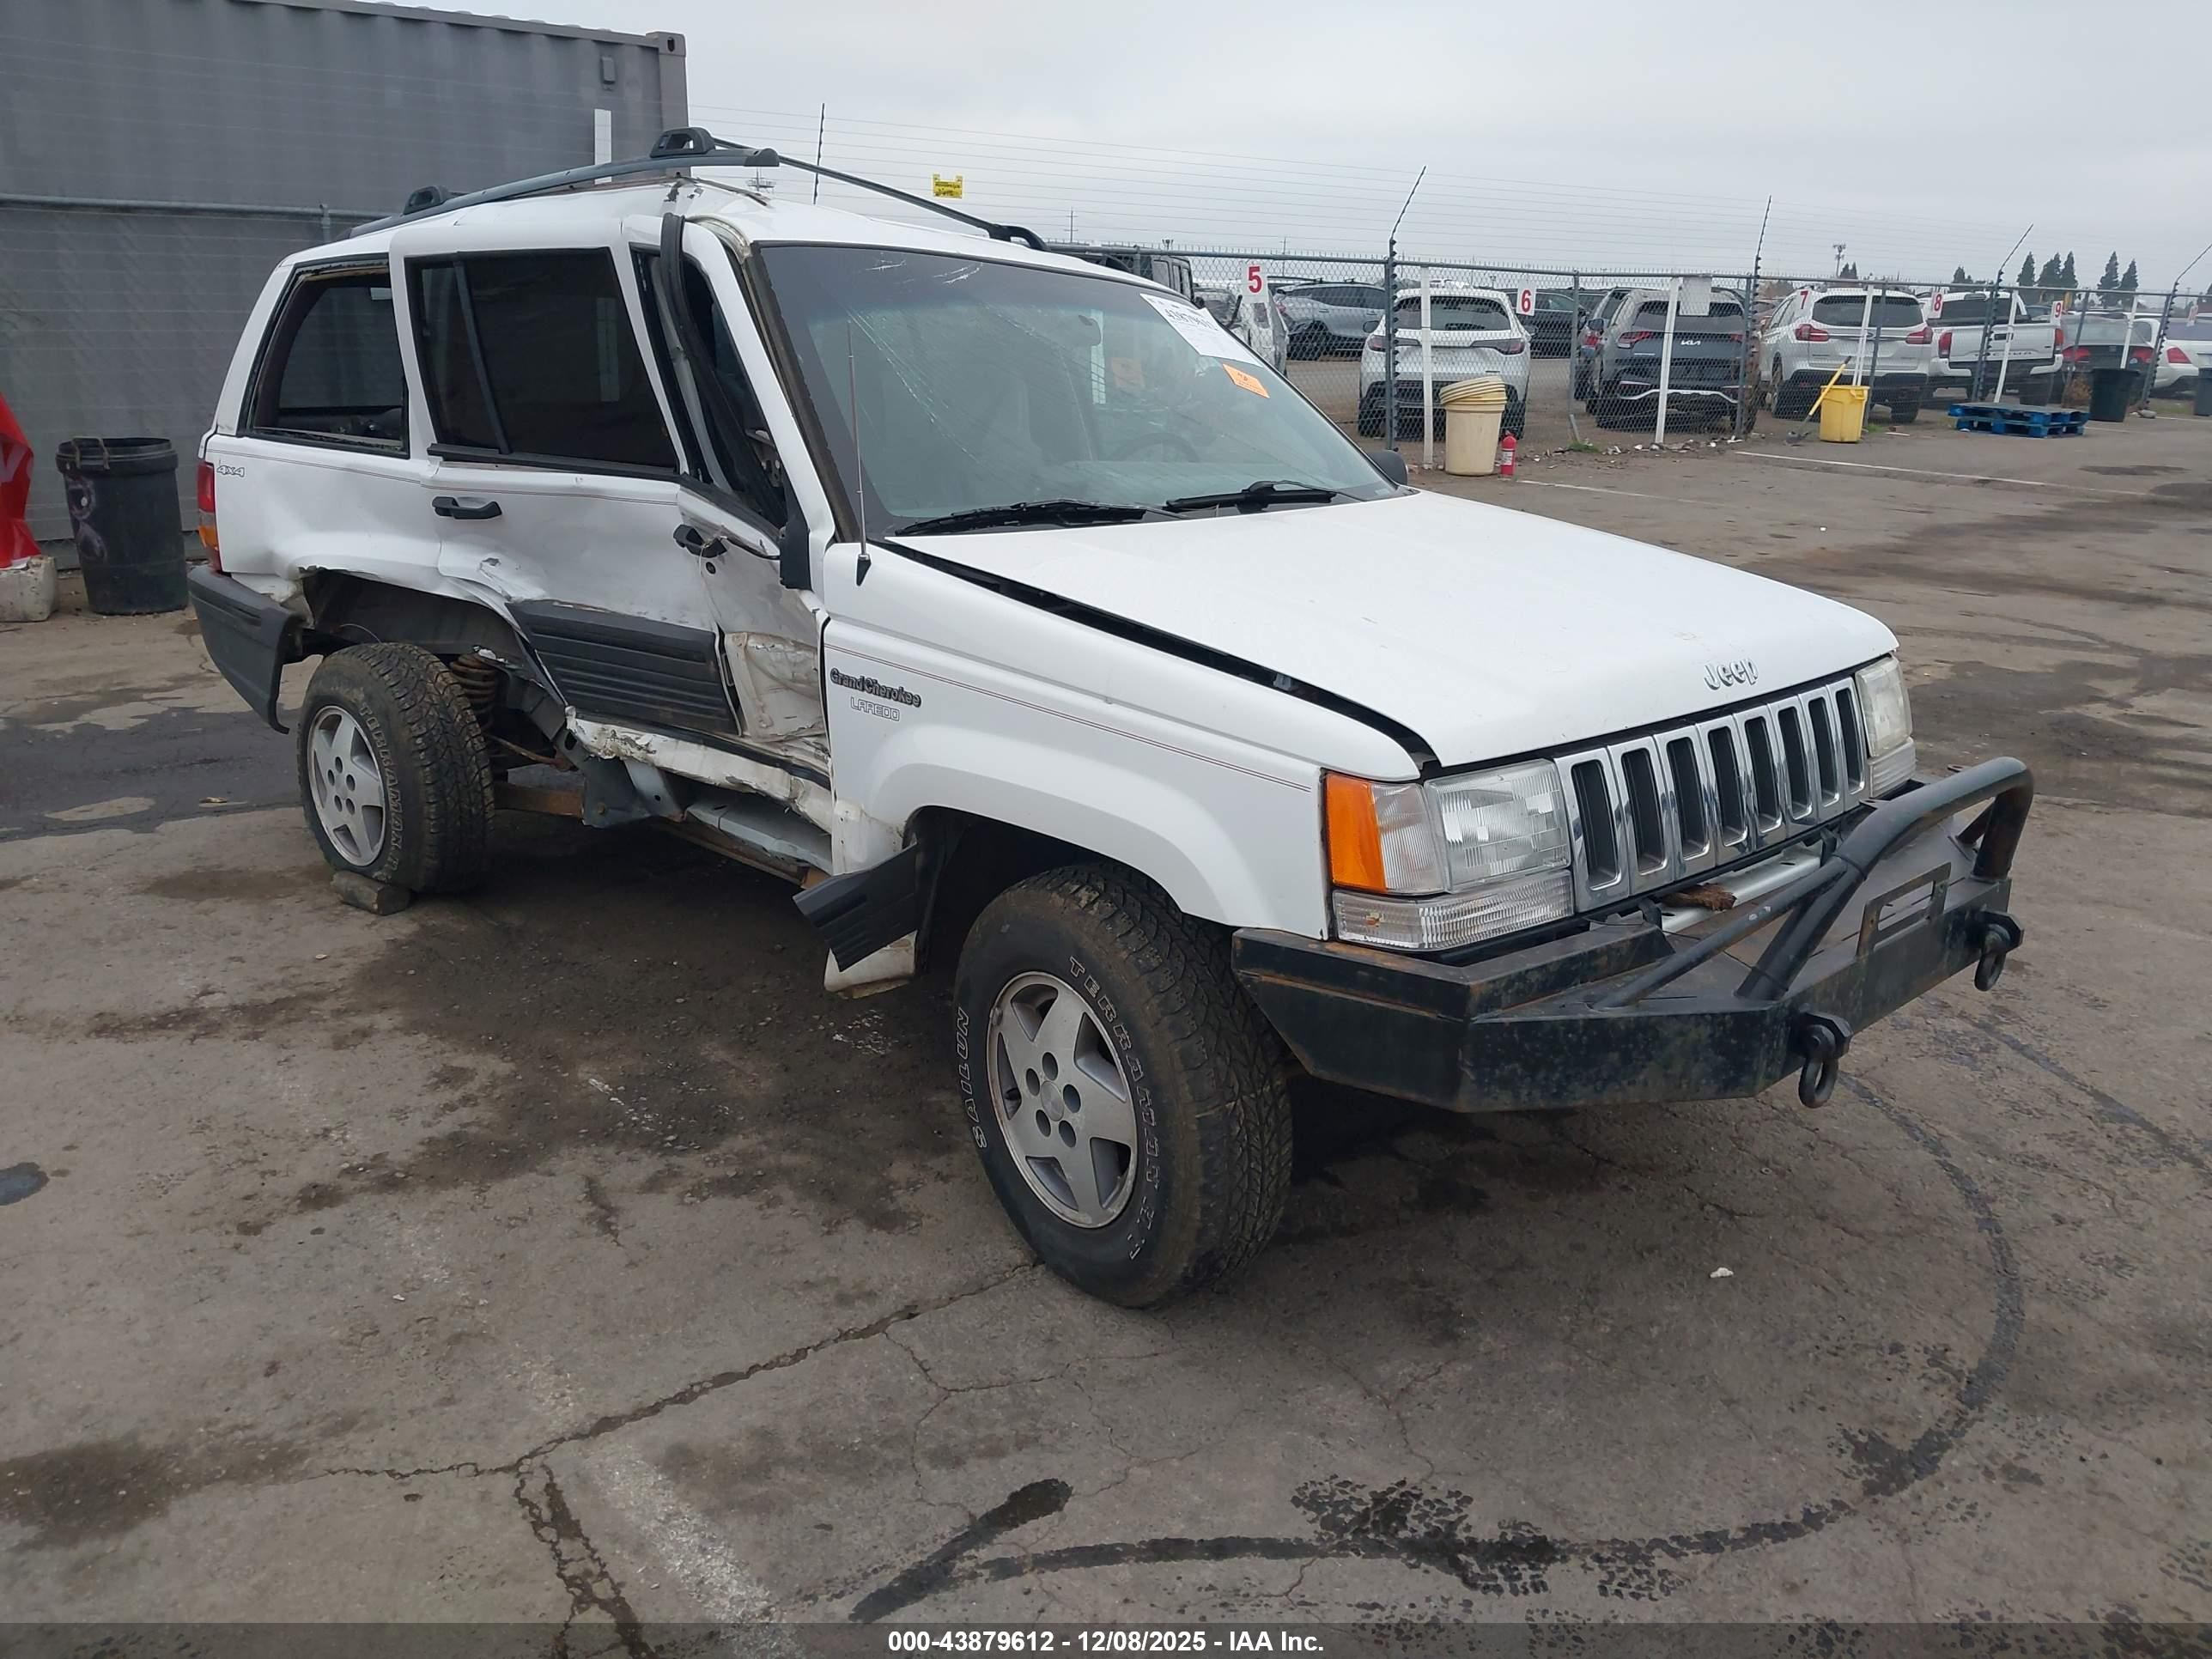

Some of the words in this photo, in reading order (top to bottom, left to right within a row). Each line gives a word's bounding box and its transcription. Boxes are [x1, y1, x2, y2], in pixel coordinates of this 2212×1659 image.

[1249, 266, 1262, 293] 5
[1521, 289, 1531, 313] 6
[1800, 290, 1808, 309] 7
[1934, 294, 1942, 312] 8
[2054, 302, 2062, 318] 9
[1704, 658, 1759, 690] Jeep
[830, 667, 866, 692] Grand
[865, 678, 921, 708] Cherokee
[850, 696, 901, 722] LAREDO
[957, 1006, 988, 1149] SAILUN
